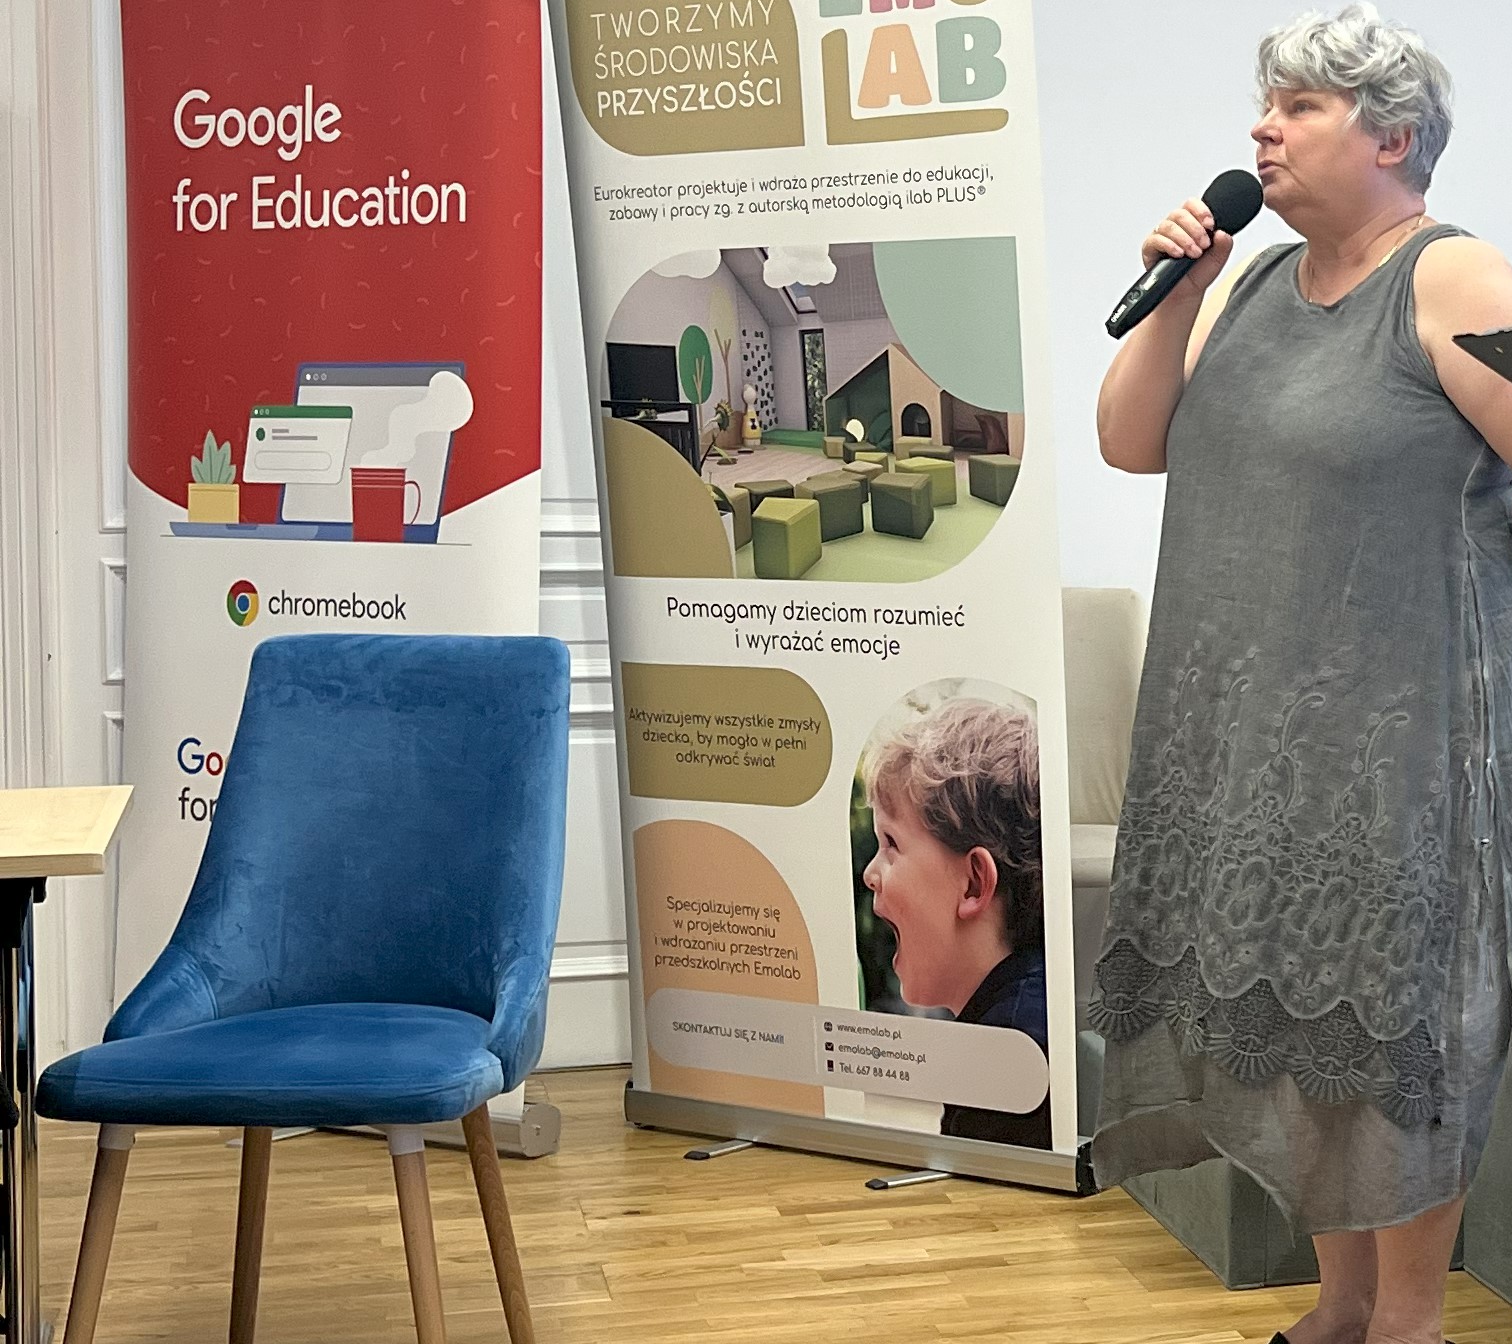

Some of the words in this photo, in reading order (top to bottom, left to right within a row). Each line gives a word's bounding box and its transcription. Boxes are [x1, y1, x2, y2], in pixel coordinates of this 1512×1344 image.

[595, 37, 778, 80] ŚRODOWISKA
[597, 71, 782, 118] PRZYSZŁOŚCI
[821, 15, 1010, 145] LAB
[173, 84, 342, 162] Google
[593, 183, 673, 201] Eurokreator
[677, 179, 748, 200] projektuje
[751, 177, 756, 192] i
[758, 175, 807, 192] wdraża
[811, 168, 899, 192] przestrzenie
[902, 167, 922, 183] do
[926, 163, 995, 184] edukacji,
[172, 178, 238, 232] for
[252, 169, 466, 230] Education
[609, 205, 658, 223] zabawy
[662, 203, 666, 218] i
[670, 203, 709, 221] pracy
[714, 202, 734, 218] zg.
[737, 202, 745, 214] z
[749, 195, 809, 214] autorską
[812, 190, 903, 211] metodologią
[906, 188, 932, 205] ilab
[268, 590, 406, 621] chromebook
[666, 596, 777, 625] Pomagamy
[782, 600, 867, 625] dzieciom
[873, 604, 965, 628] rozumieć
[734, 628, 740, 649] i
[746, 630, 824, 655] wyrażać
[831, 634, 900, 661] emocje
[628, 707, 711, 728] Aktywizujemy
[714, 713, 774, 730] wszystkie
[778, 716, 821, 735] zmysły
[642, 729, 694, 746] dziecka,
[697, 730, 713, 747] by
[717, 734, 758, 750] mogło
[762, 736, 771, 747] w
[775, 735, 807, 751] pełni
[177, 737, 228, 776] Go
[676, 750, 739, 767] odkrywać
[744, 751, 776, 768] świat
[666, 896, 760, 920] Specjalizujemy
[763, 905, 781, 923] się
[673, 919, 683, 929] w
[687, 918, 776, 939] projektowaniu
[730, 942, 799, 961] przestrzeni
[654, 954, 750, 974] przedszkolnych
[754, 961, 801, 980] Emolab
[672, 1021, 732, 1038] SKONTAKTUJ
[750, 1030, 757, 1041] Z
[837, 1023, 902, 1041] www.emolab.pl
[838, 1043, 927, 1064] emolab@emolab.pl
[885, 1069, 897, 1080] 44
